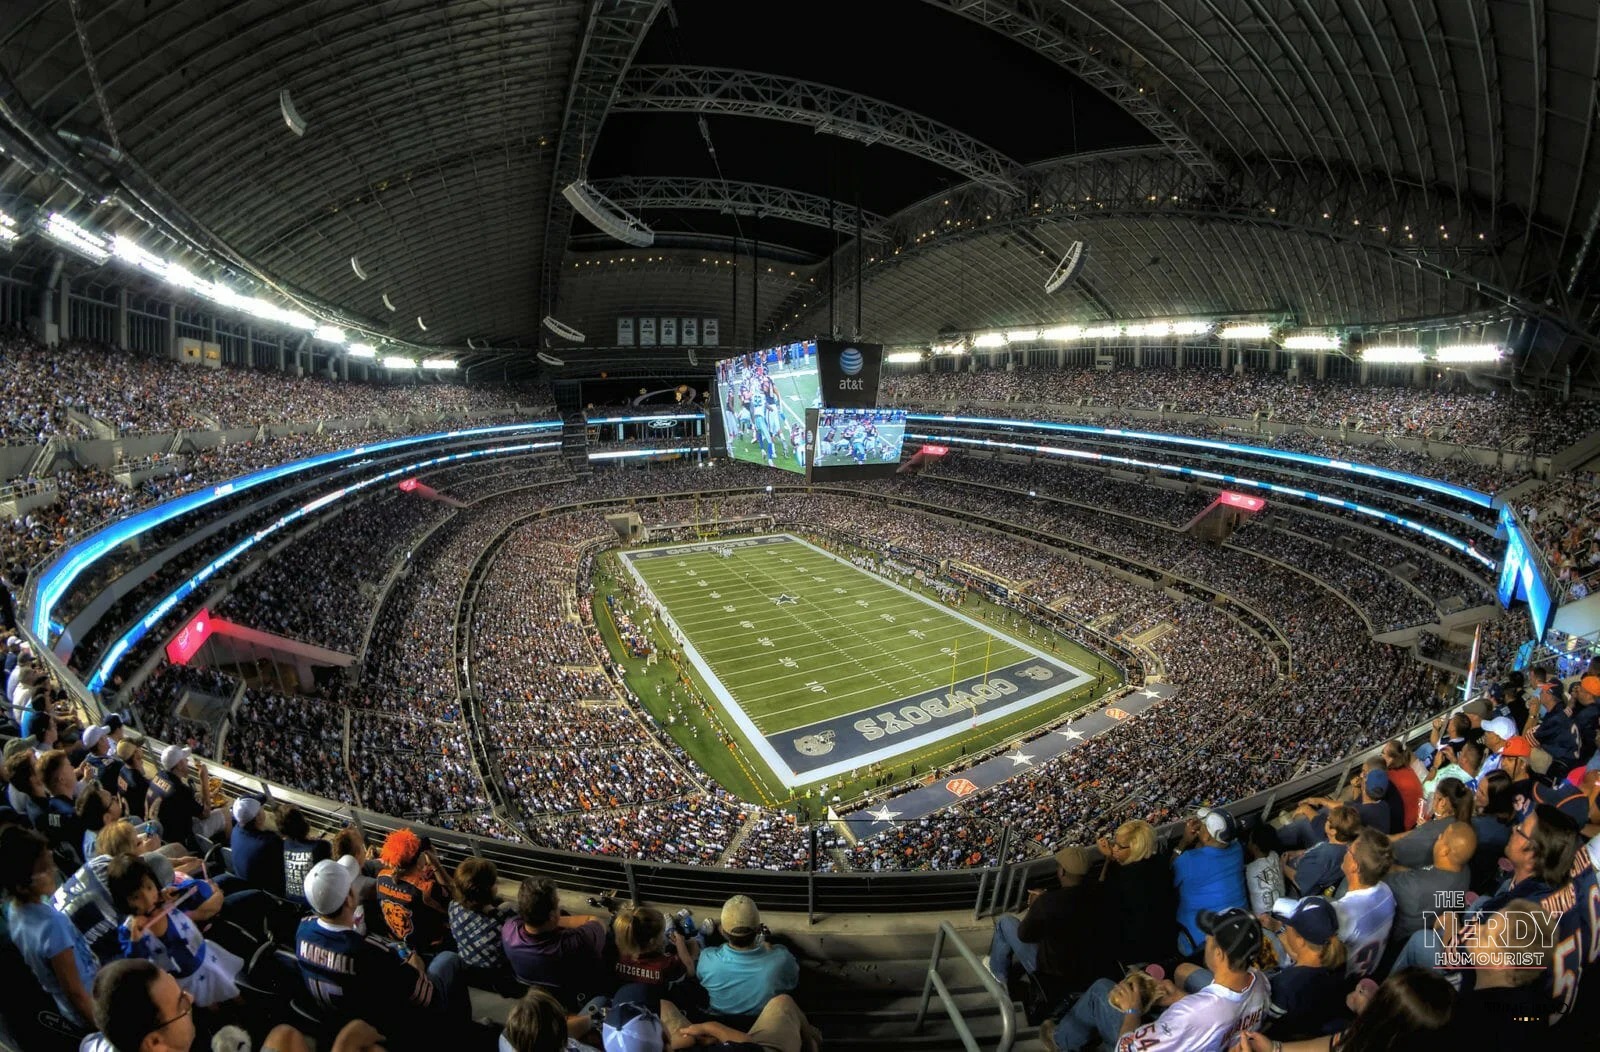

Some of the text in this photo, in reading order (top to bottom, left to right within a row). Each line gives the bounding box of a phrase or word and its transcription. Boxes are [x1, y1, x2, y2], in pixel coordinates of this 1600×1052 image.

[839, 378, 864, 391] at&t
[854, 678, 1019, 741] COWBOYS
[300, 940, 357, 975] MARSHALL
[615, 962, 660, 980] FITZGERALD
